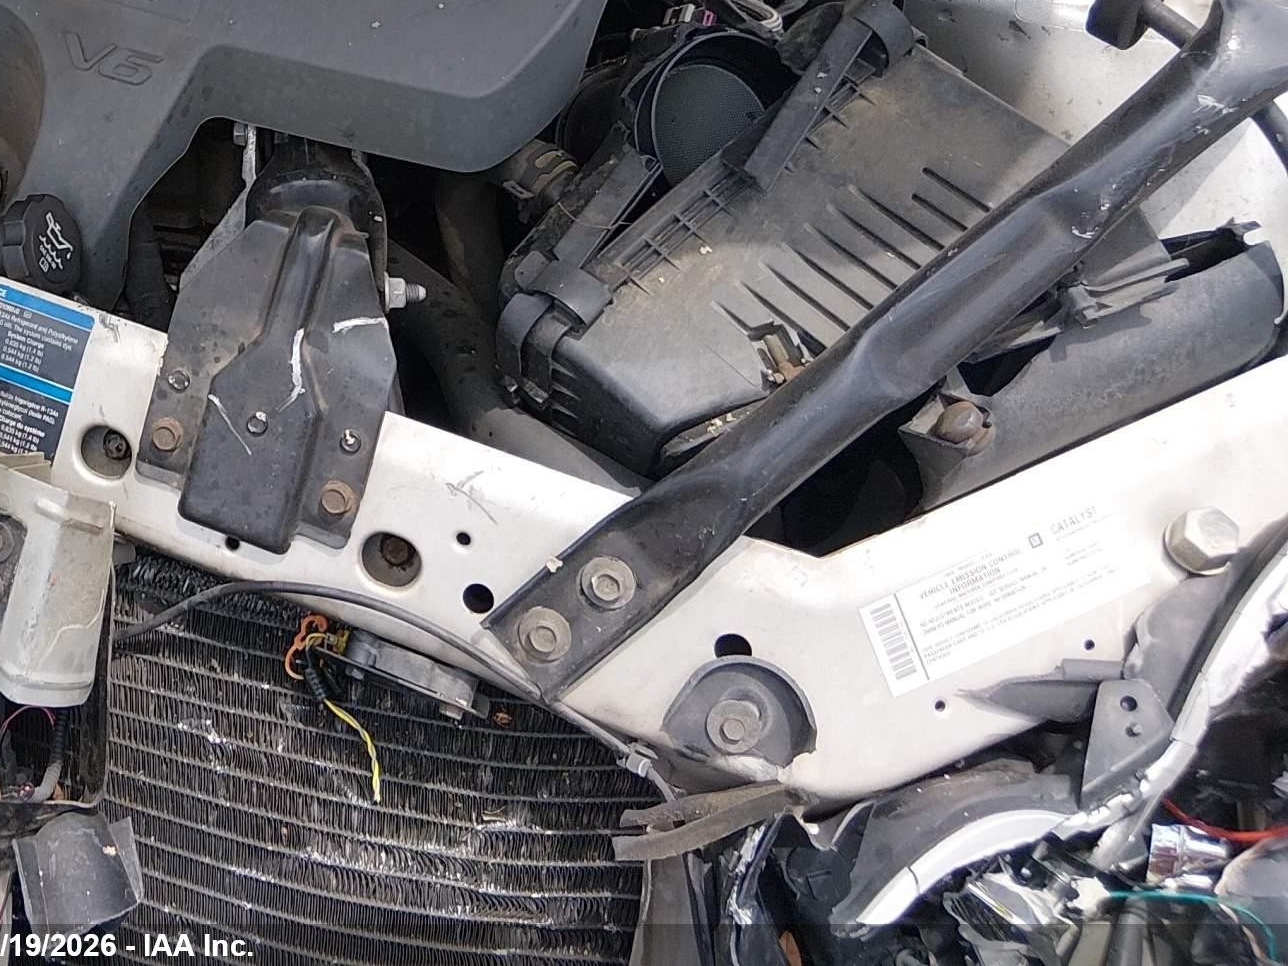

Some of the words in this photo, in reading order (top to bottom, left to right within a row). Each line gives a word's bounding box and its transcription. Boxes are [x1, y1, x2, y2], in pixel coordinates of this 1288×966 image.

[63, 28, 164, 87] V6
[7, 331, 26, 343] System
[26, 338, 45, 350] Charge
[16, 422, 24, 430] du
[1050, 506, 1097, 534] CATALYST
[920, 581, 950, 599] VEHICLE
[951, 564, 987, 585] EMISSION
[988, 548, 1021, 567] CONTROL
[949, 567, 1001, 594] INFORMATION
